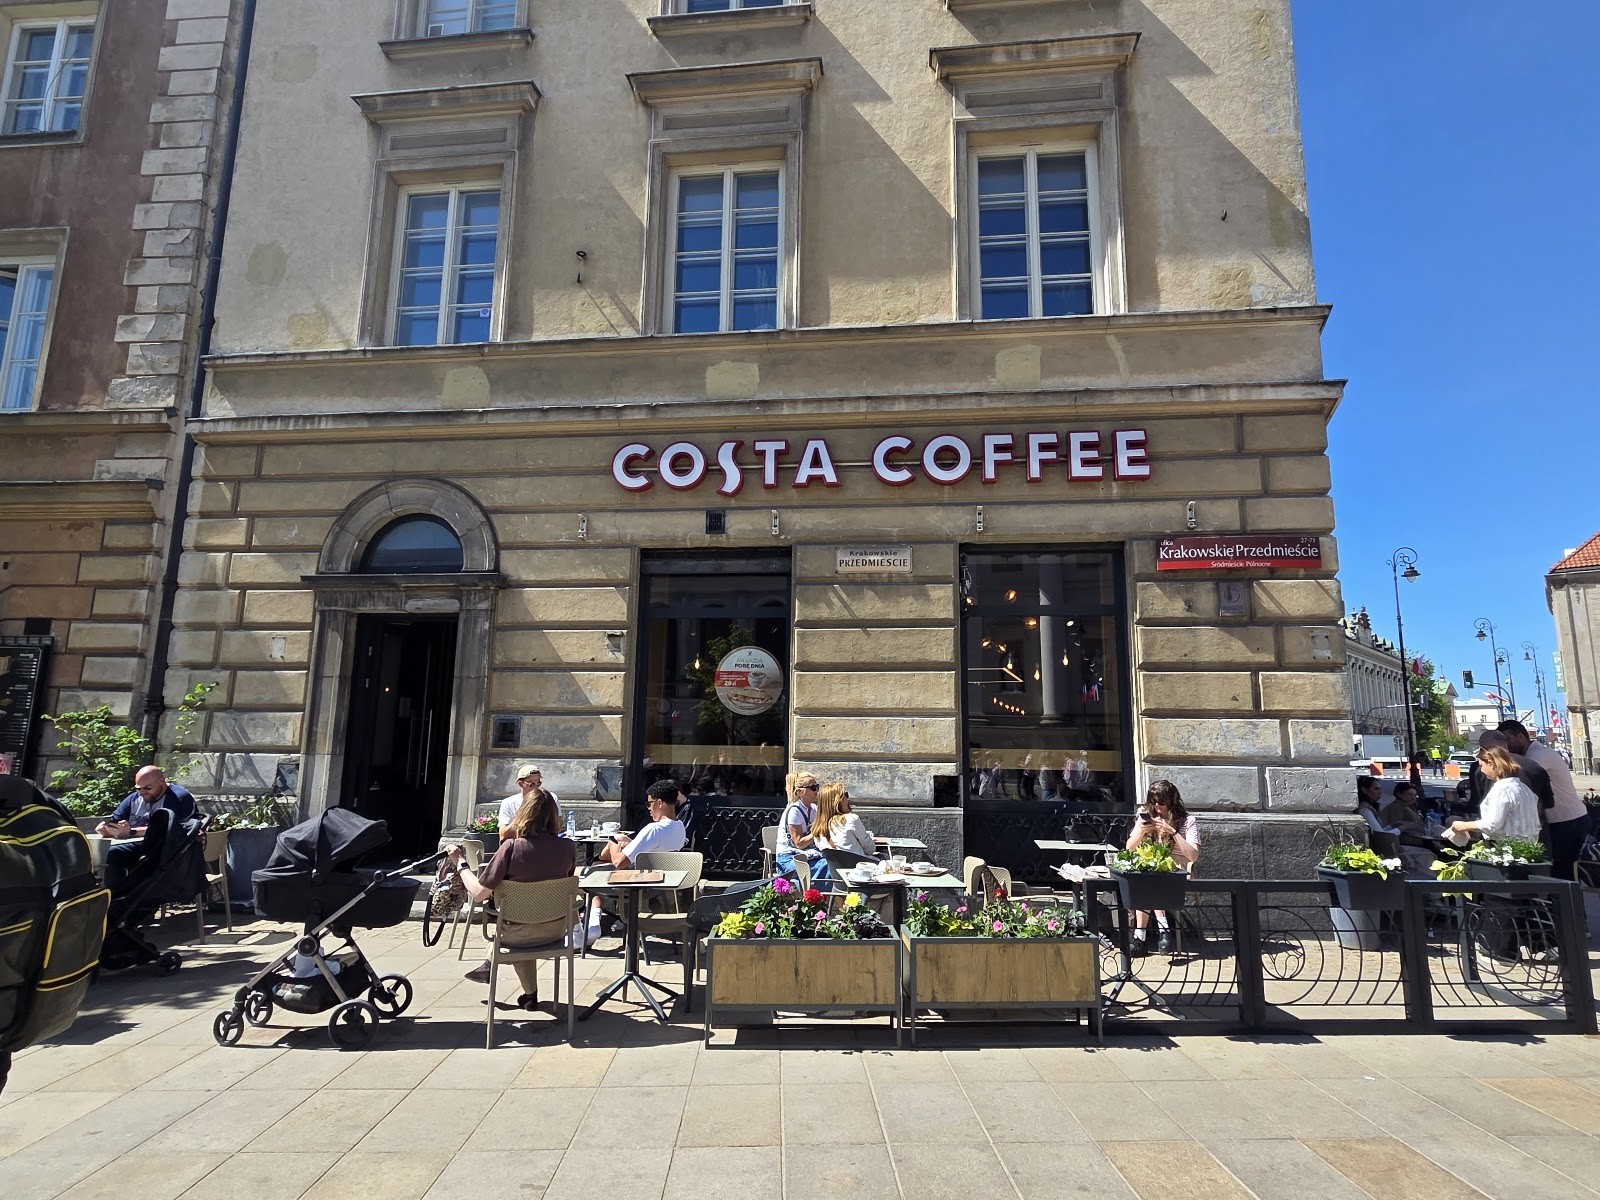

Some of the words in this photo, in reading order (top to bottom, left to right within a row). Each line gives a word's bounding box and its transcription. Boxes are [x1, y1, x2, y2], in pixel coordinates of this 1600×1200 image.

[612, 438, 840, 497] COSTA
[871, 428, 1153, 486] COFFEE
[1160, 545, 1233, 559] Krakowskie
[1236, 543, 1318, 557] Przedmieście
[1553, 656, 1565, 688] PTTK
